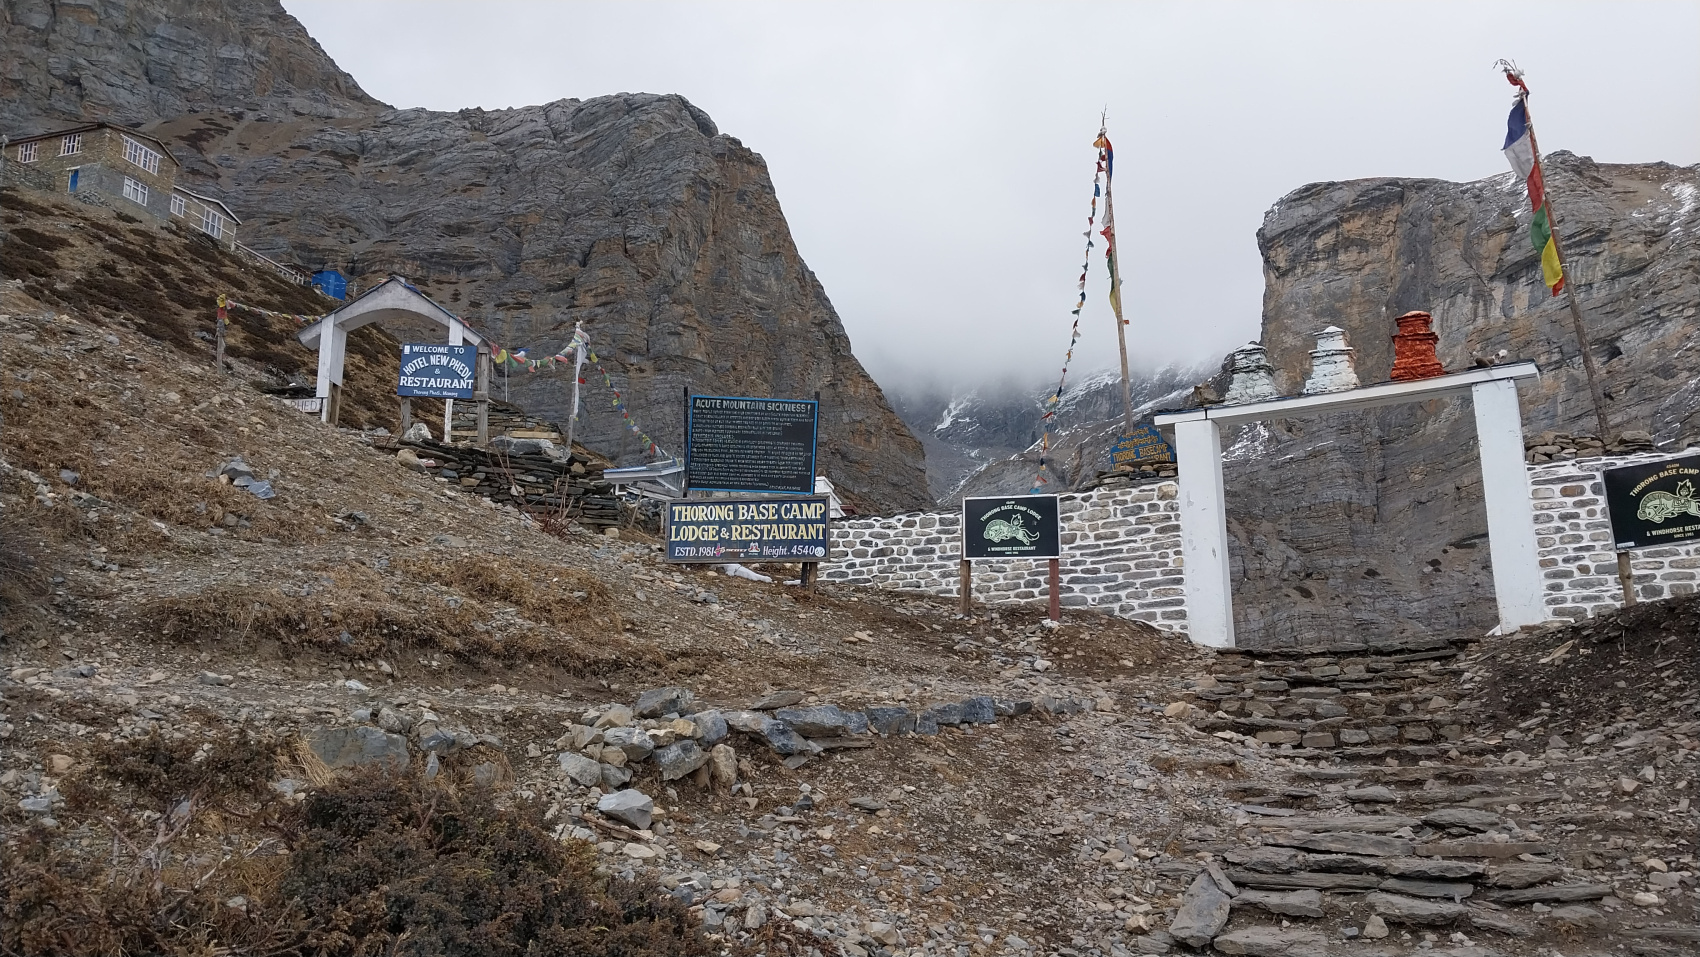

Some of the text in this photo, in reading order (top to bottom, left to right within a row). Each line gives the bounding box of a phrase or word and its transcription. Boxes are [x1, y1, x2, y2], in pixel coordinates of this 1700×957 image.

[412, 345, 449, 354] WELCOME
[403, 355, 471, 380] HOTEL NEW PHEDI
[400, 376, 473, 389] RESTAURANT
[696, 399, 721, 408] ACUTE
[723, 400, 765, 410] MOUNTAIN
[767, 402, 805, 412] SICKNESS
[1629, 474, 1658, 497] THORONG
[1659, 469, 1677, 478] BASE
[673, 503, 825, 521] THORONG BASE CAMP
[980, 507, 1000, 521] THORONG
[1027, 508, 1042, 520] LODGE
[670, 524, 825, 541] LODGE & RESTAURANT
[1652, 527, 1683, 536] WINDHORSE
[791, 545, 815, 555] 4540
